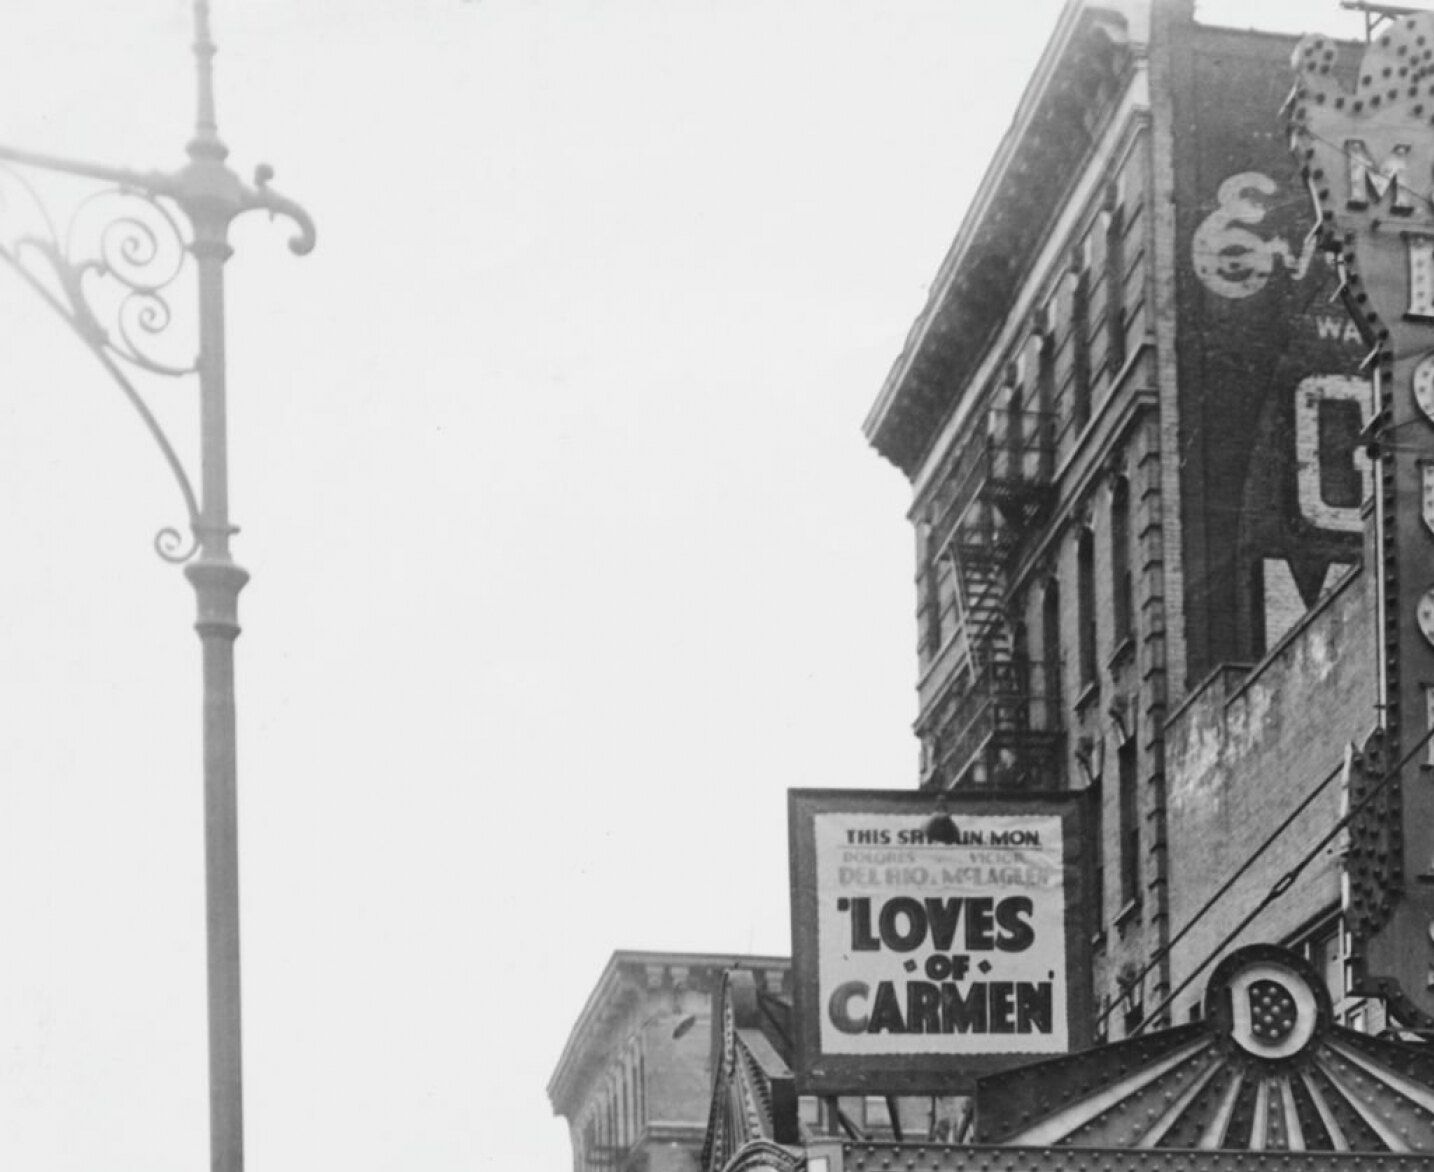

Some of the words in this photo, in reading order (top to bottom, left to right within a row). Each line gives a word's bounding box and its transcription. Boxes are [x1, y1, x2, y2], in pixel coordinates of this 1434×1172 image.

[846, 828, 891, 845] THIS
[838, 866, 881, 886] DEL
[924, 953, 970, 982] OF
